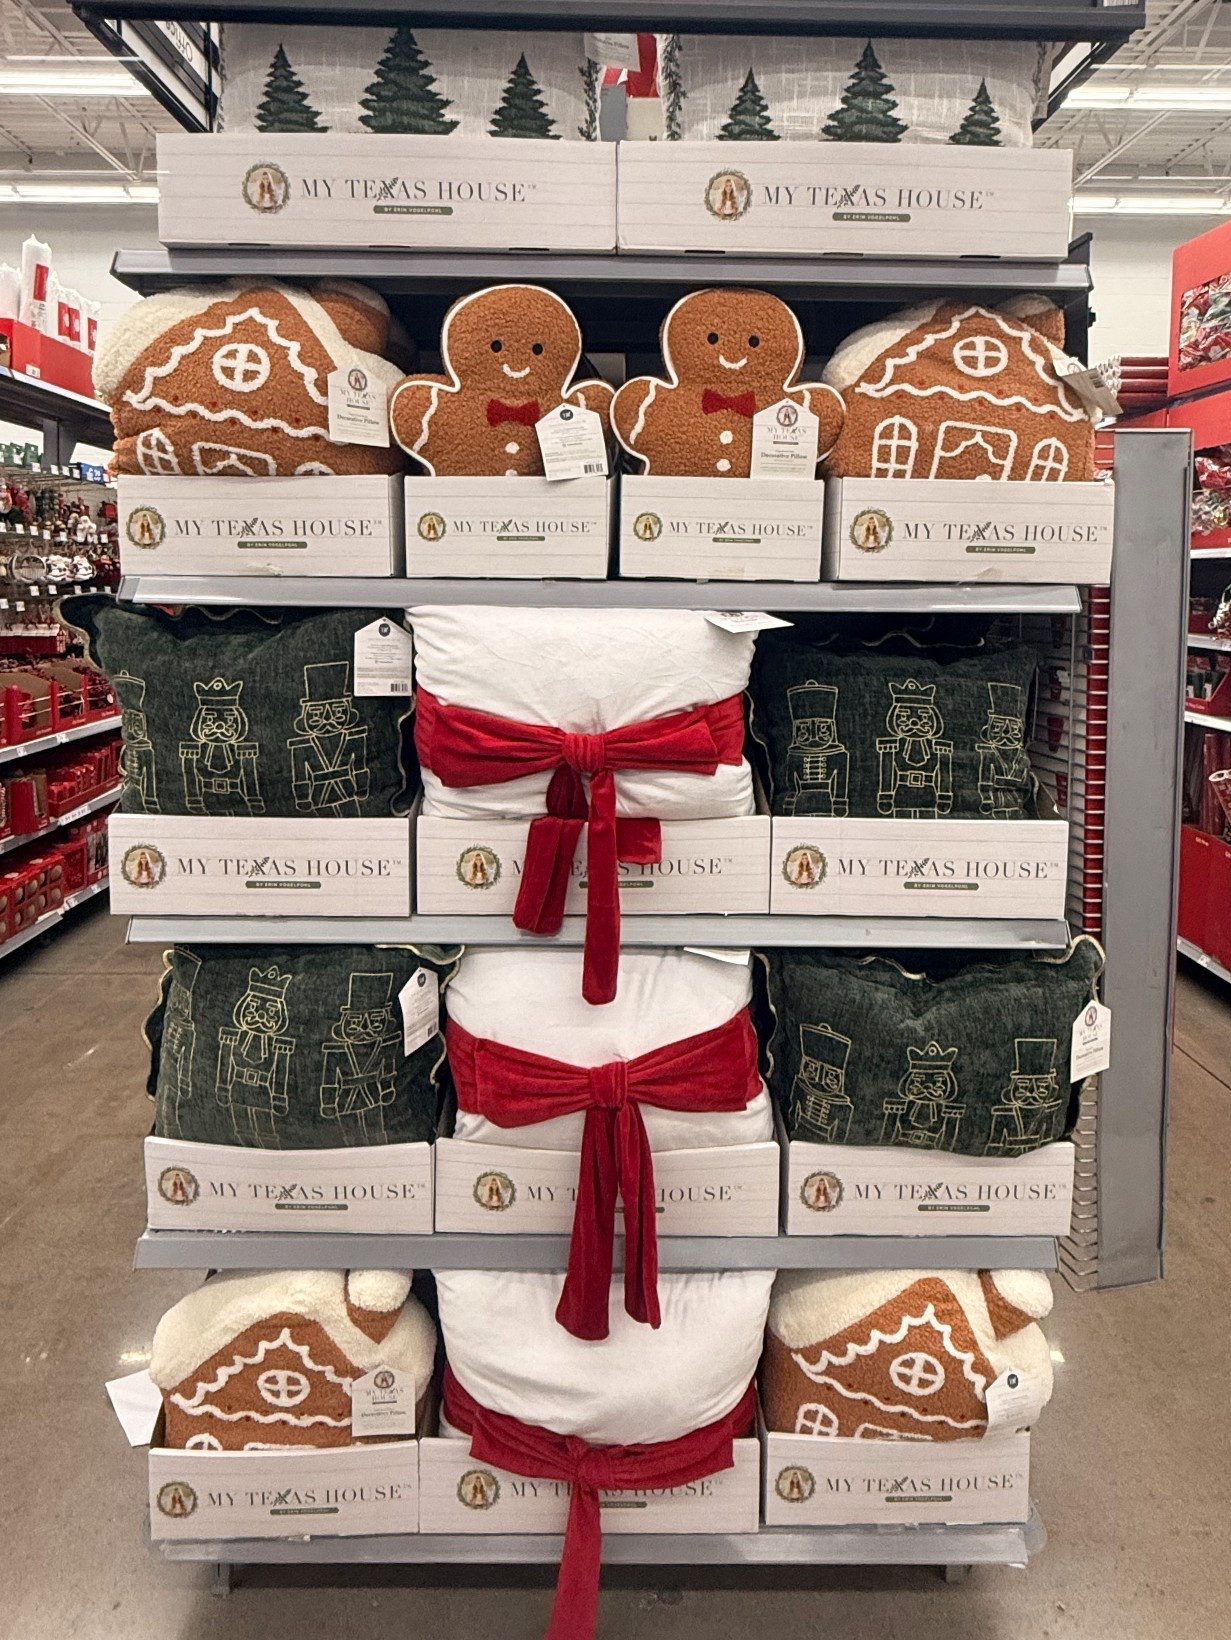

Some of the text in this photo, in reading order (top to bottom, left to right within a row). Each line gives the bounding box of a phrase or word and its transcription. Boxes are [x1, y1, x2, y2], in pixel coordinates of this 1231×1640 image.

[301, 178, 334, 198] MY
[345, 177, 428, 201] TEXAS
[762, 185, 799, 205] MY
[807, 184, 886, 209] TEXAS
[760, 451, 790, 459] Decorative
[174, 518, 207, 537] MY
[211, 517, 284, 538] TEXAS
[453, 520, 474, 533] MY
[479, 519, 530, 534] TEXAS
[670, 521, 689, 534] MY
[695, 520, 746, 536] TEXAS
[902, 522, 936, 540] MY
[943, 521, 1015, 543] TEXAS
[177, 858, 211, 875] MY
[218, 856, 297, 878] TEXAS
[838, 858, 869, 876] MY
[879, 857, 956, 879] TEXAS
[210, 1181, 241, 1198] MY
[248, 1182, 324, 1202] TEXAS
[527, 1185, 558, 1202] MY
[853, 1183, 884, 1200] MY
[894, 1182, 968, 1202] TEXAS
[511, 1481, 544, 1497] MY
[826, 1477, 855, 1492] MY
[862, 1475, 932, 1494] TEXAS
[208, 1491, 238, 1506] MY
[244, 1488, 317, 1507] TEXAS
